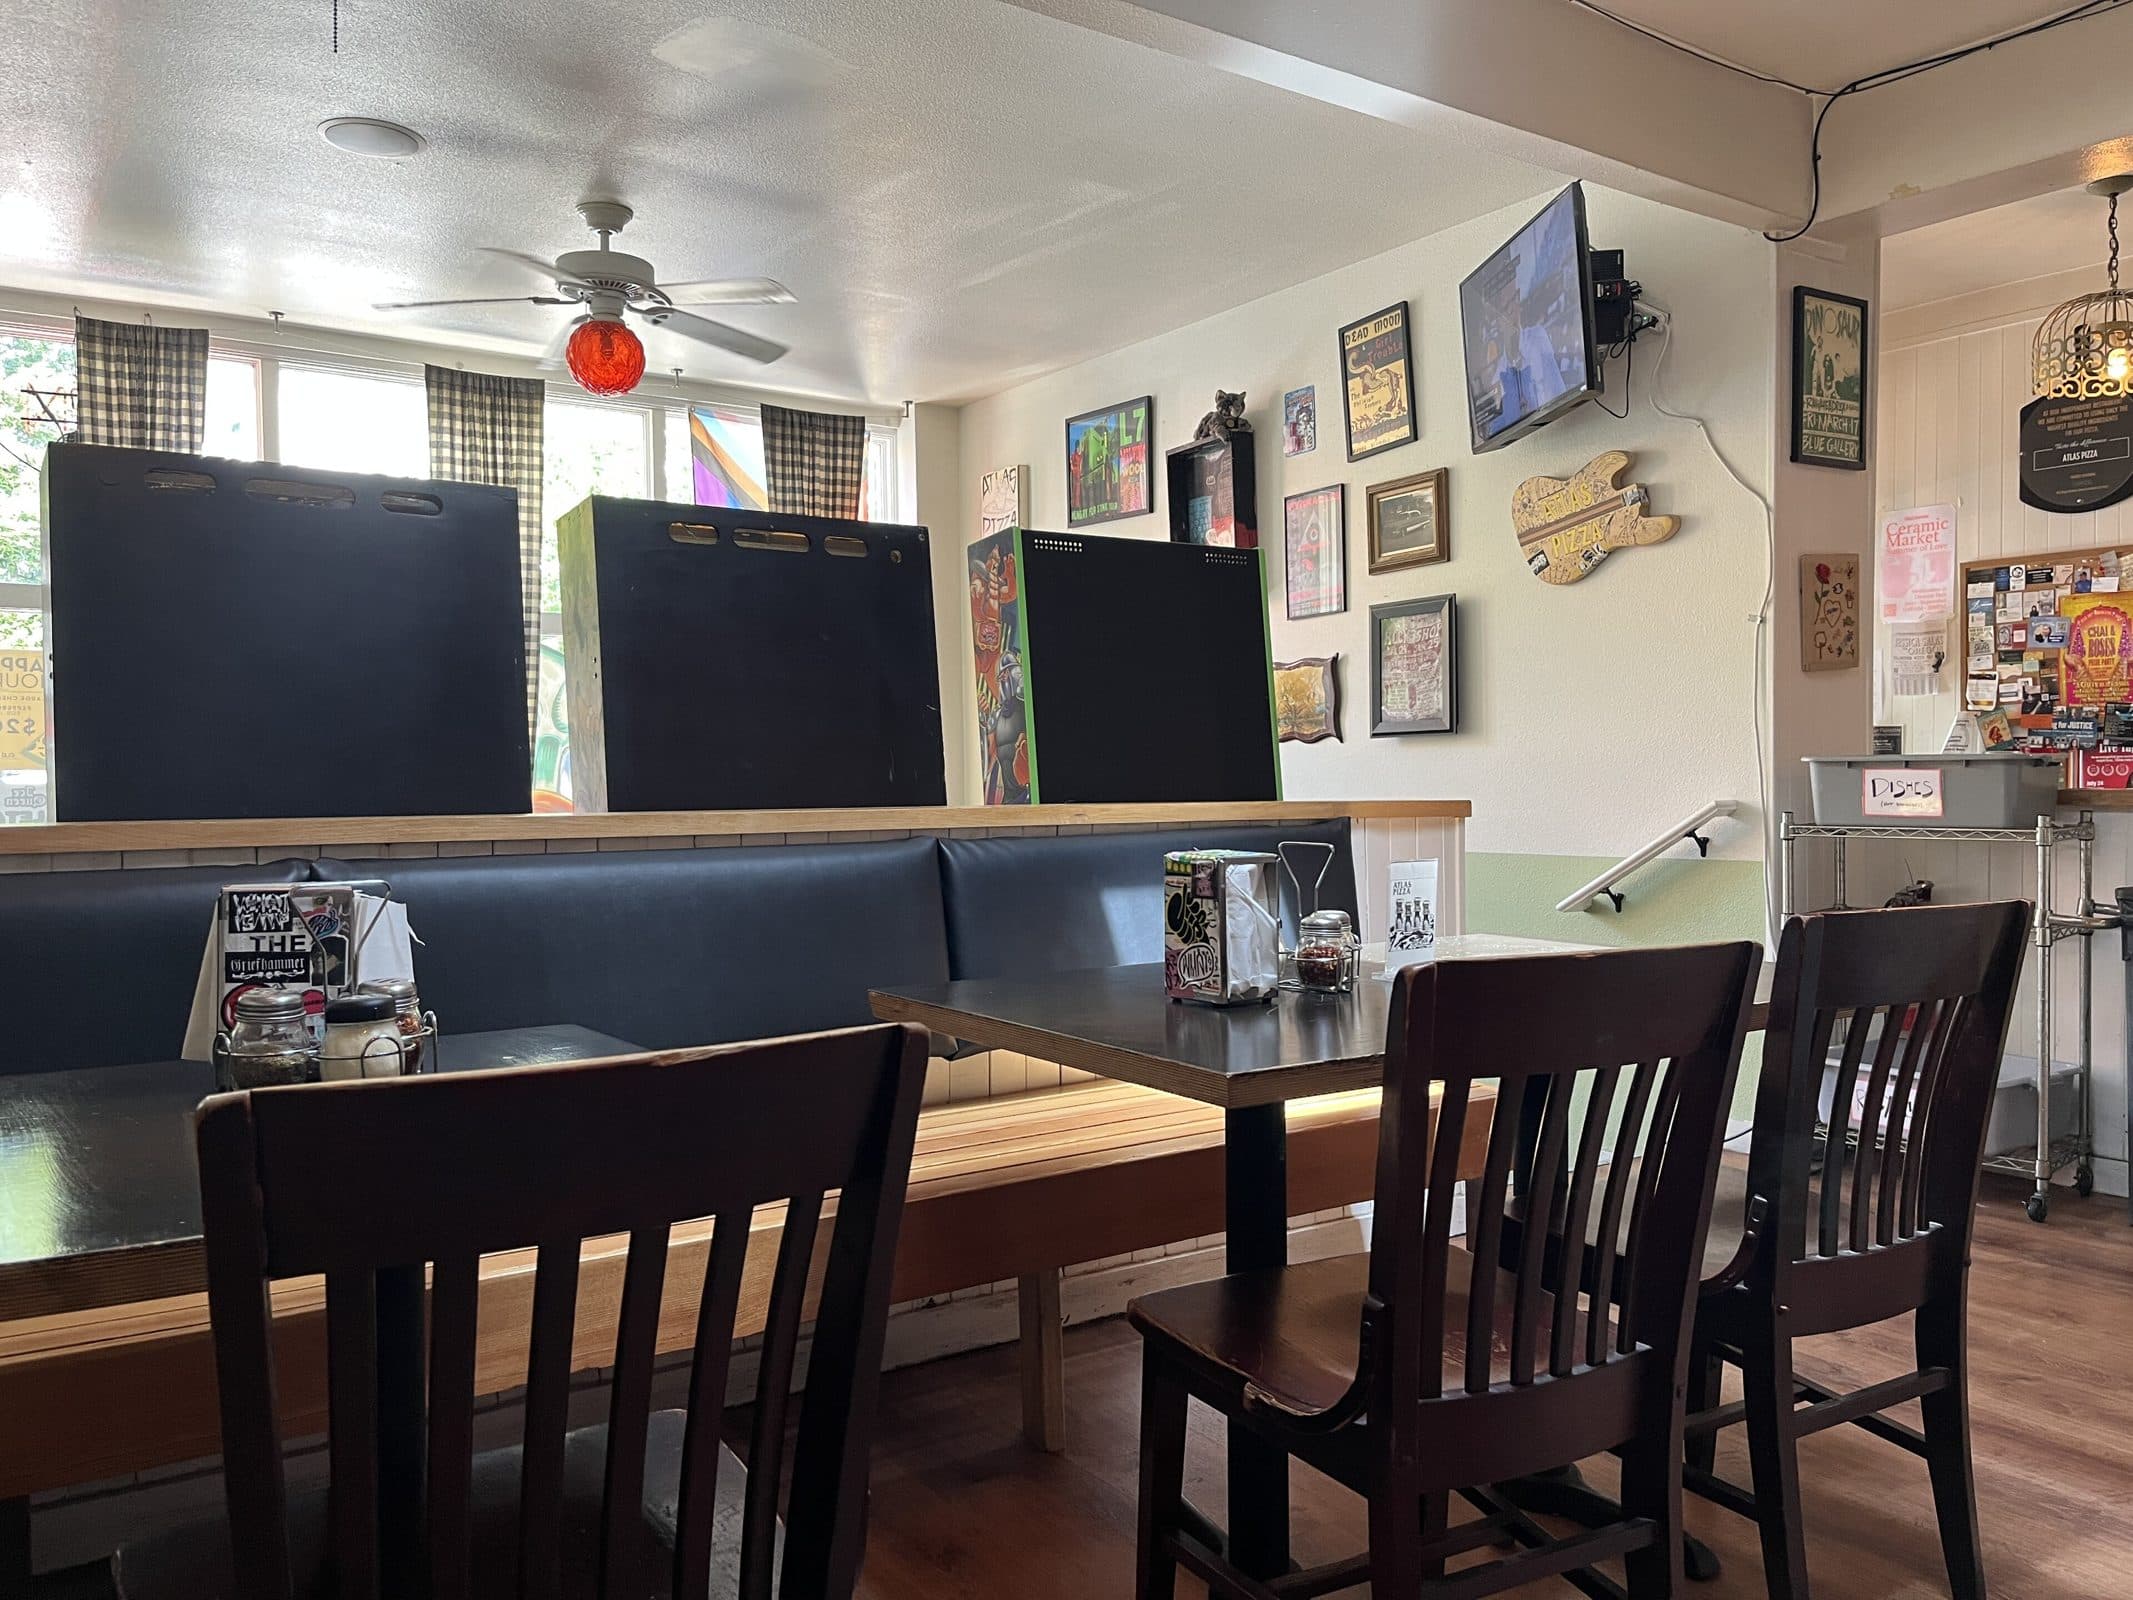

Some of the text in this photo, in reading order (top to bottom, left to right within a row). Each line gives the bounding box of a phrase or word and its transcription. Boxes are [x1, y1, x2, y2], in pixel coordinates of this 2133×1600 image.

[1345, 312, 1402, 347] DEAD MOON
[1119, 408, 1146, 446] L7
[1818, 413, 1848, 434] MARCH
[1803, 434, 1858, 458] BLUE GALLERY
[2062, 449, 2098, 462] ATLAS PIZZA
[1542, 483, 1594, 517] ATLAS
[1886, 517, 1949, 536] Ceramic
[1550, 521, 1605, 559] PIZZA
[1887, 531, 1940, 547] Market
[2088, 625, 2109, 637] CHAI
[2058, 721, 2067, 730] for
[2067, 721, 2094, 730] JUSTICE
[1871, 777, 1934, 799] DISHES
[1393, 881, 1412, 889] ATLAS
[1393, 888, 1411, 896] PIZZA
[250, 935, 307, 952] THE
[231, 957, 305, 972] Griefhammer
